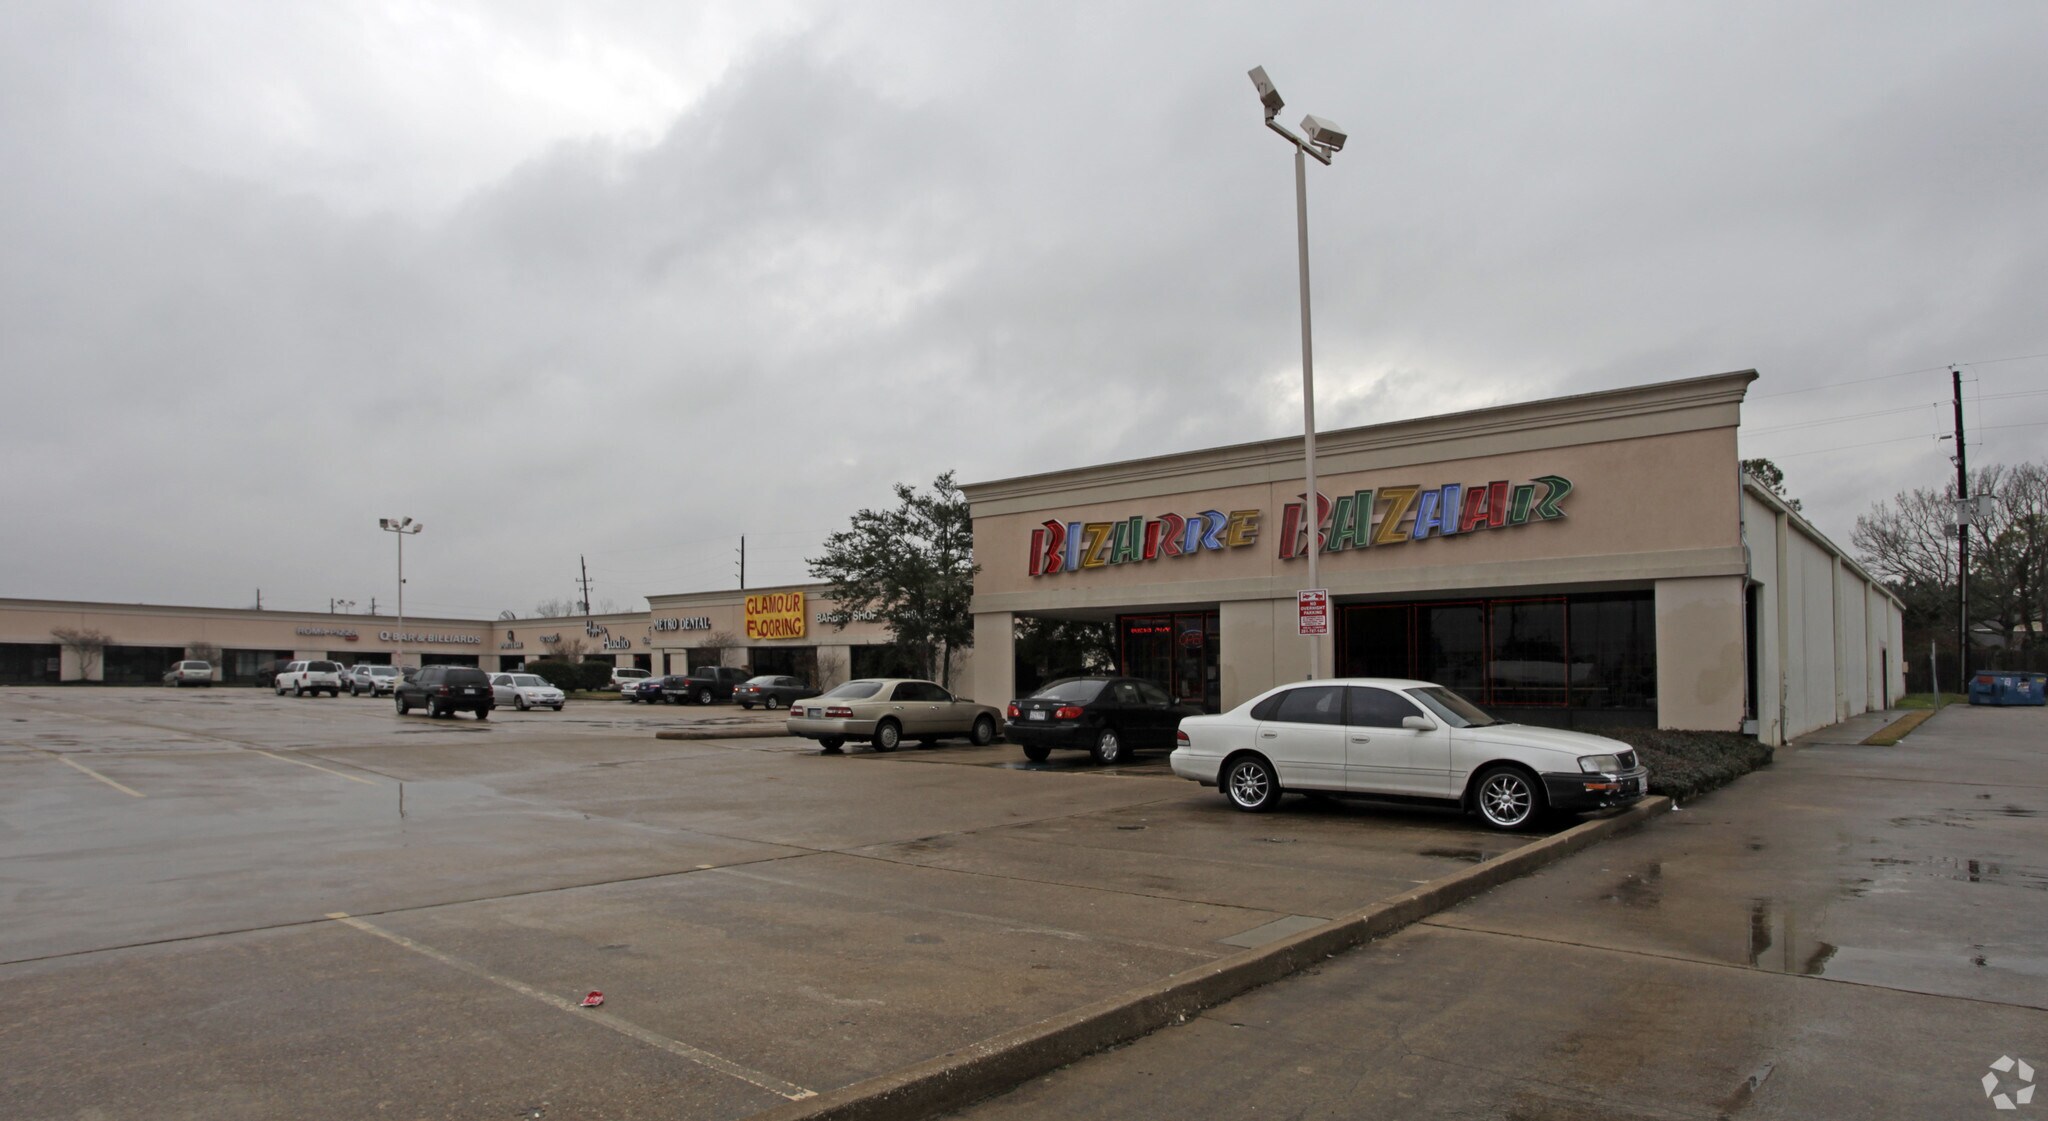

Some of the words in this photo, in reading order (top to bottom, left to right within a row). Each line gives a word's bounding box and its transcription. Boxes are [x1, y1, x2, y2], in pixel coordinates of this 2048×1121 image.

[1029, 509, 1260, 576] BIZARRE
[1279, 475, 1574, 560] BAZAAR
[746, 594, 800, 615] GLAMOUR
[654, 617, 678, 631] METRO
[680, 616, 710, 630] DENTAL
[746, 617, 801, 638] FLOORING
[428, 633, 481, 644] BILLIARDS
[603, 633, 631, 650] Audio
